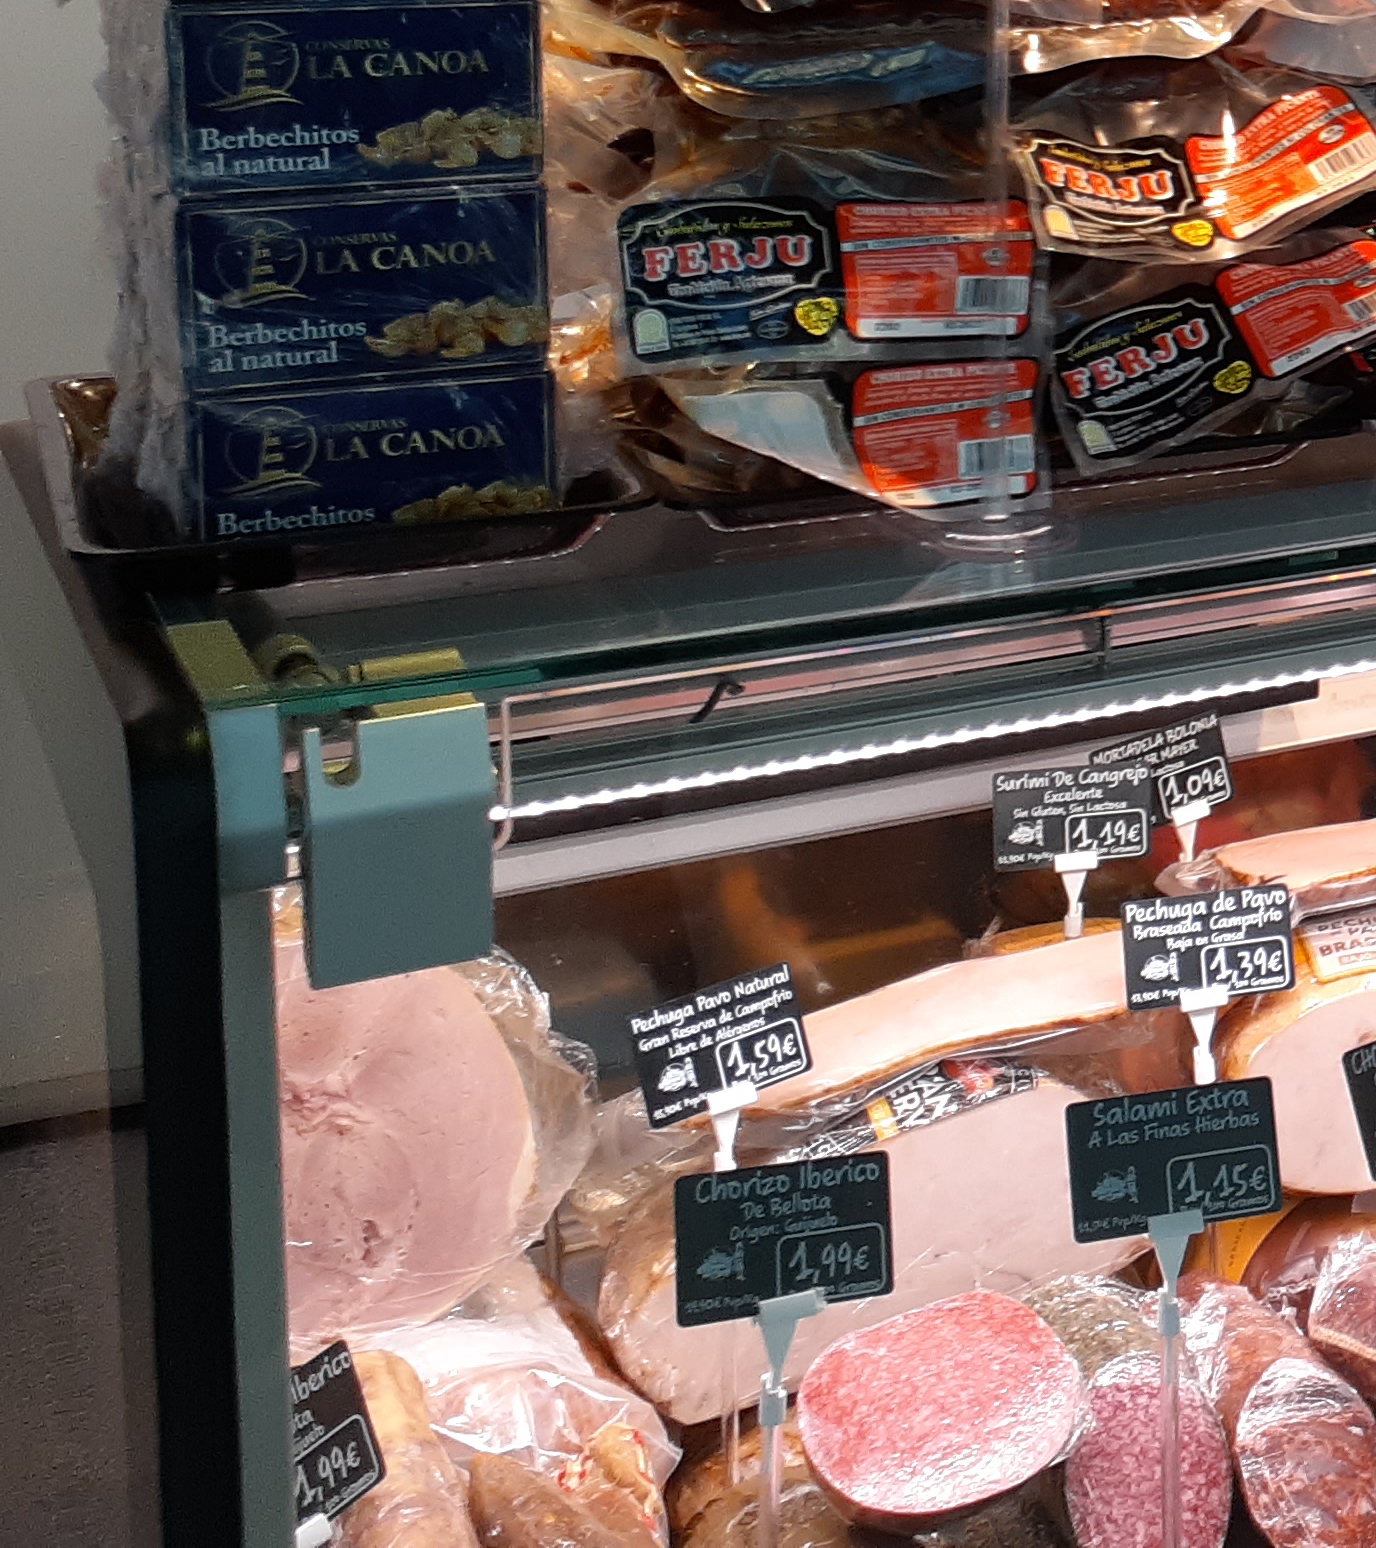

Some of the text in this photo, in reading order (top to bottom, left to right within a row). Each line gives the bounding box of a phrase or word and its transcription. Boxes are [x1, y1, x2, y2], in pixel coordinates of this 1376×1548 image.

[363, 51, 490, 78] CANOA
[200, 126, 361, 152] Berbechitos
[1040, 157, 1175, 202] FERJU
[371, 241, 497, 271] CANOA
[643, 235, 813, 281] FERJU
[1061, 317, 1210, 400] FERJU
[217, 504, 376, 536] Berbechitos
[996, 771, 1051, 792] Surimi
[1078, 760, 1149, 787] Cangrejo
[1072, 818, 1142, 850] 1,19€
[1125, 888, 1287, 926] Pechuga de Pavo
[1209, 946, 1284, 983] 1,39€
[631, 963, 791, 1035] Pechuga Pavo Natural
[727, 1033, 798, 1081] 1,59€
[1092, 1087, 1250, 1128] Salami Extra
[695, 1154, 880, 1205] Chorizo Iberico
[1177, 1160, 1267, 1205] 1,15€
[771, 1194, 832, 1219] Bellota
[789, 1240, 870, 1284] 1,99€
